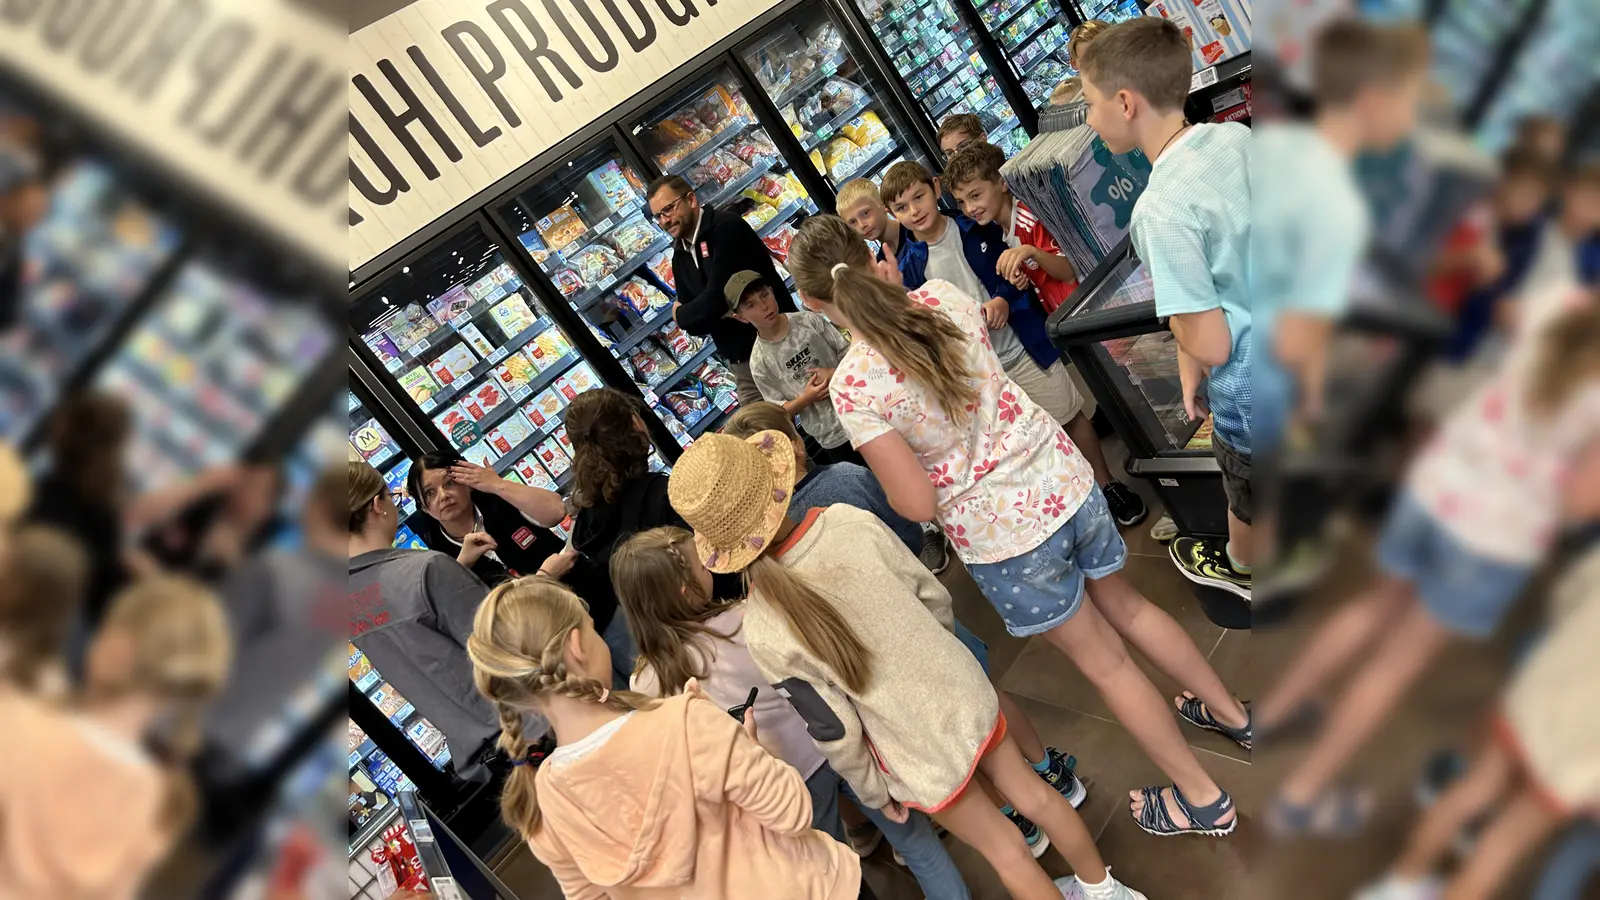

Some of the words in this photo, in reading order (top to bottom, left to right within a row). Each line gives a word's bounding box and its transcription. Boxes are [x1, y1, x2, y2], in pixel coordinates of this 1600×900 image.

[1224, 108, 1246, 122] AKTION
[785, 347, 810, 369] SKATE
[359, 431, 375, 445] M
[374, 691, 383, 702] ja!
[414, 725, 424, 736] ja!
